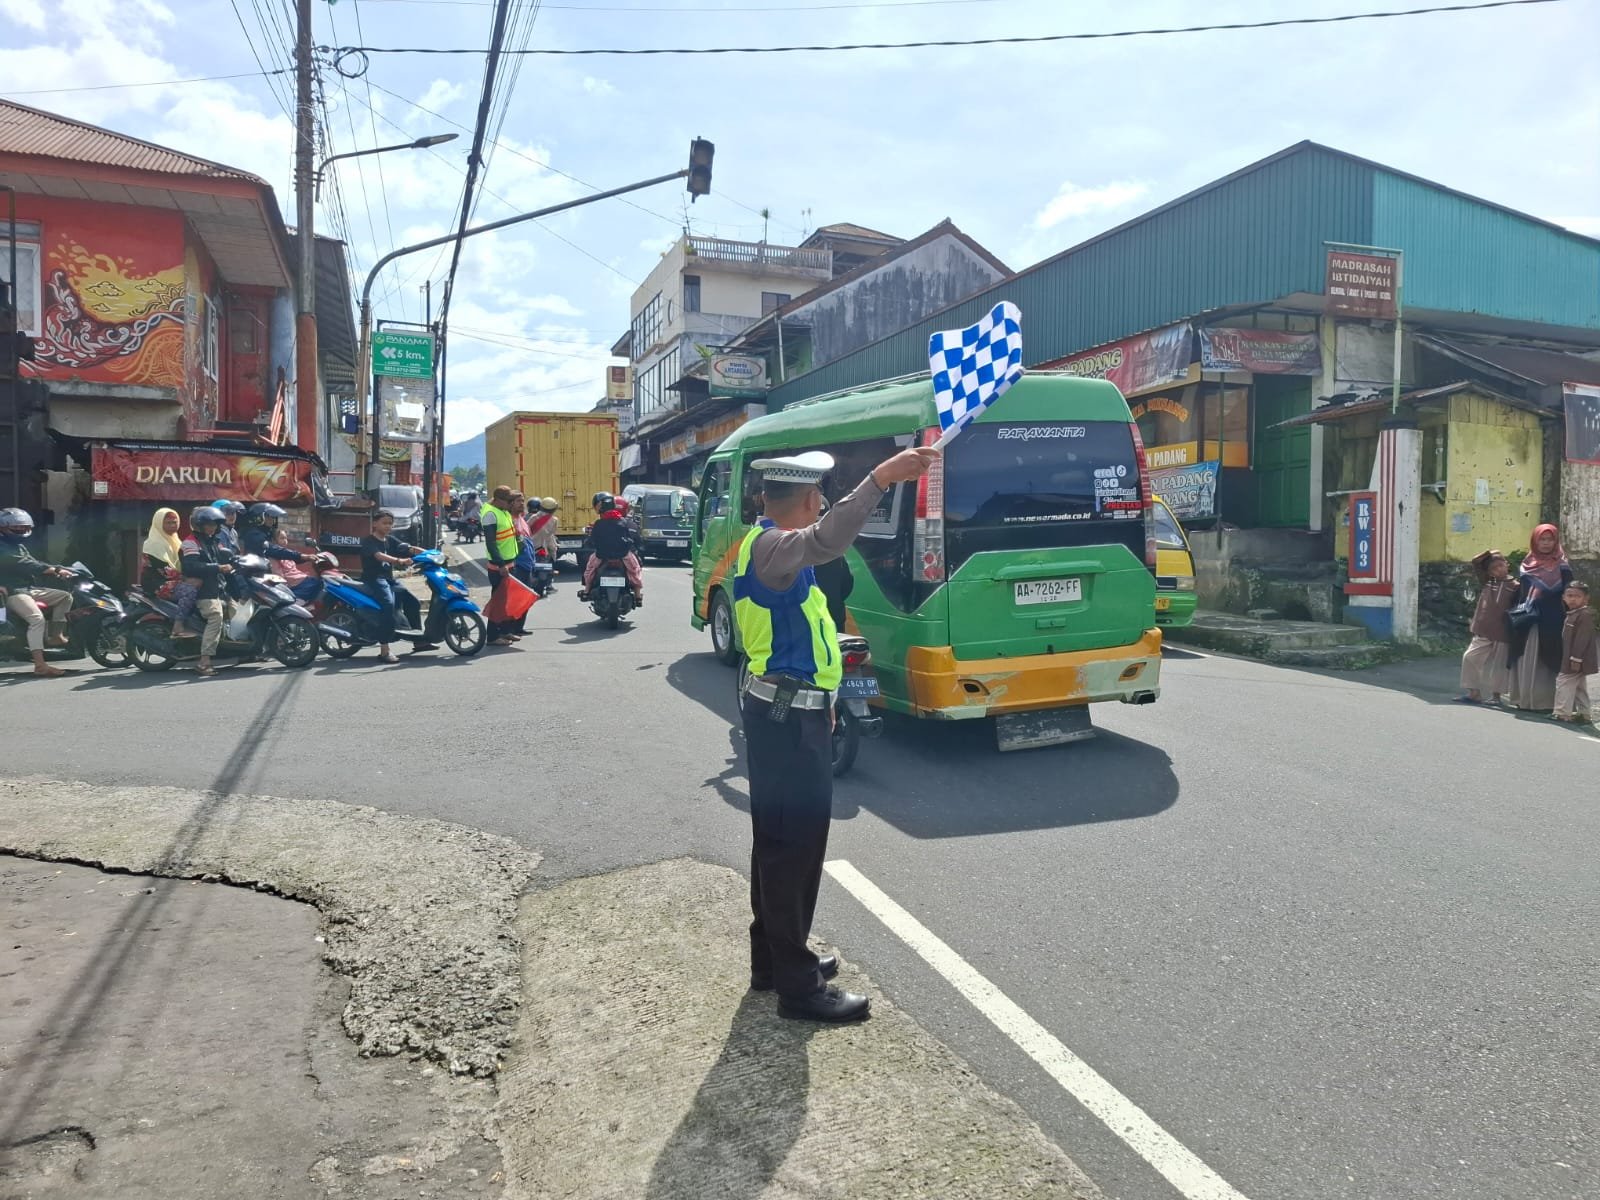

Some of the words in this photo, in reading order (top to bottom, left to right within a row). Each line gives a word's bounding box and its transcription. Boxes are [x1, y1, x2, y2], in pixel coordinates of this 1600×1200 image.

[1332, 259, 1391, 274] MADRASAH
[1332, 272, 1391, 287] IBTIDAIYAH
[386, 335, 429, 345] PANAMA
[397, 350, 403, 358] 5
[1071, 349, 1123, 376] PADANG
[1154, 448, 1187, 467] PADANG
[135, 465, 232, 485] DJARUM
[249, 459, 294, 500] 76
[1161, 471, 1214, 491] PADANG
[1357, 503, 1370, 530] RW
[331, 535, 361, 545] BENSIN
[1359, 540, 1369, 567] 03
